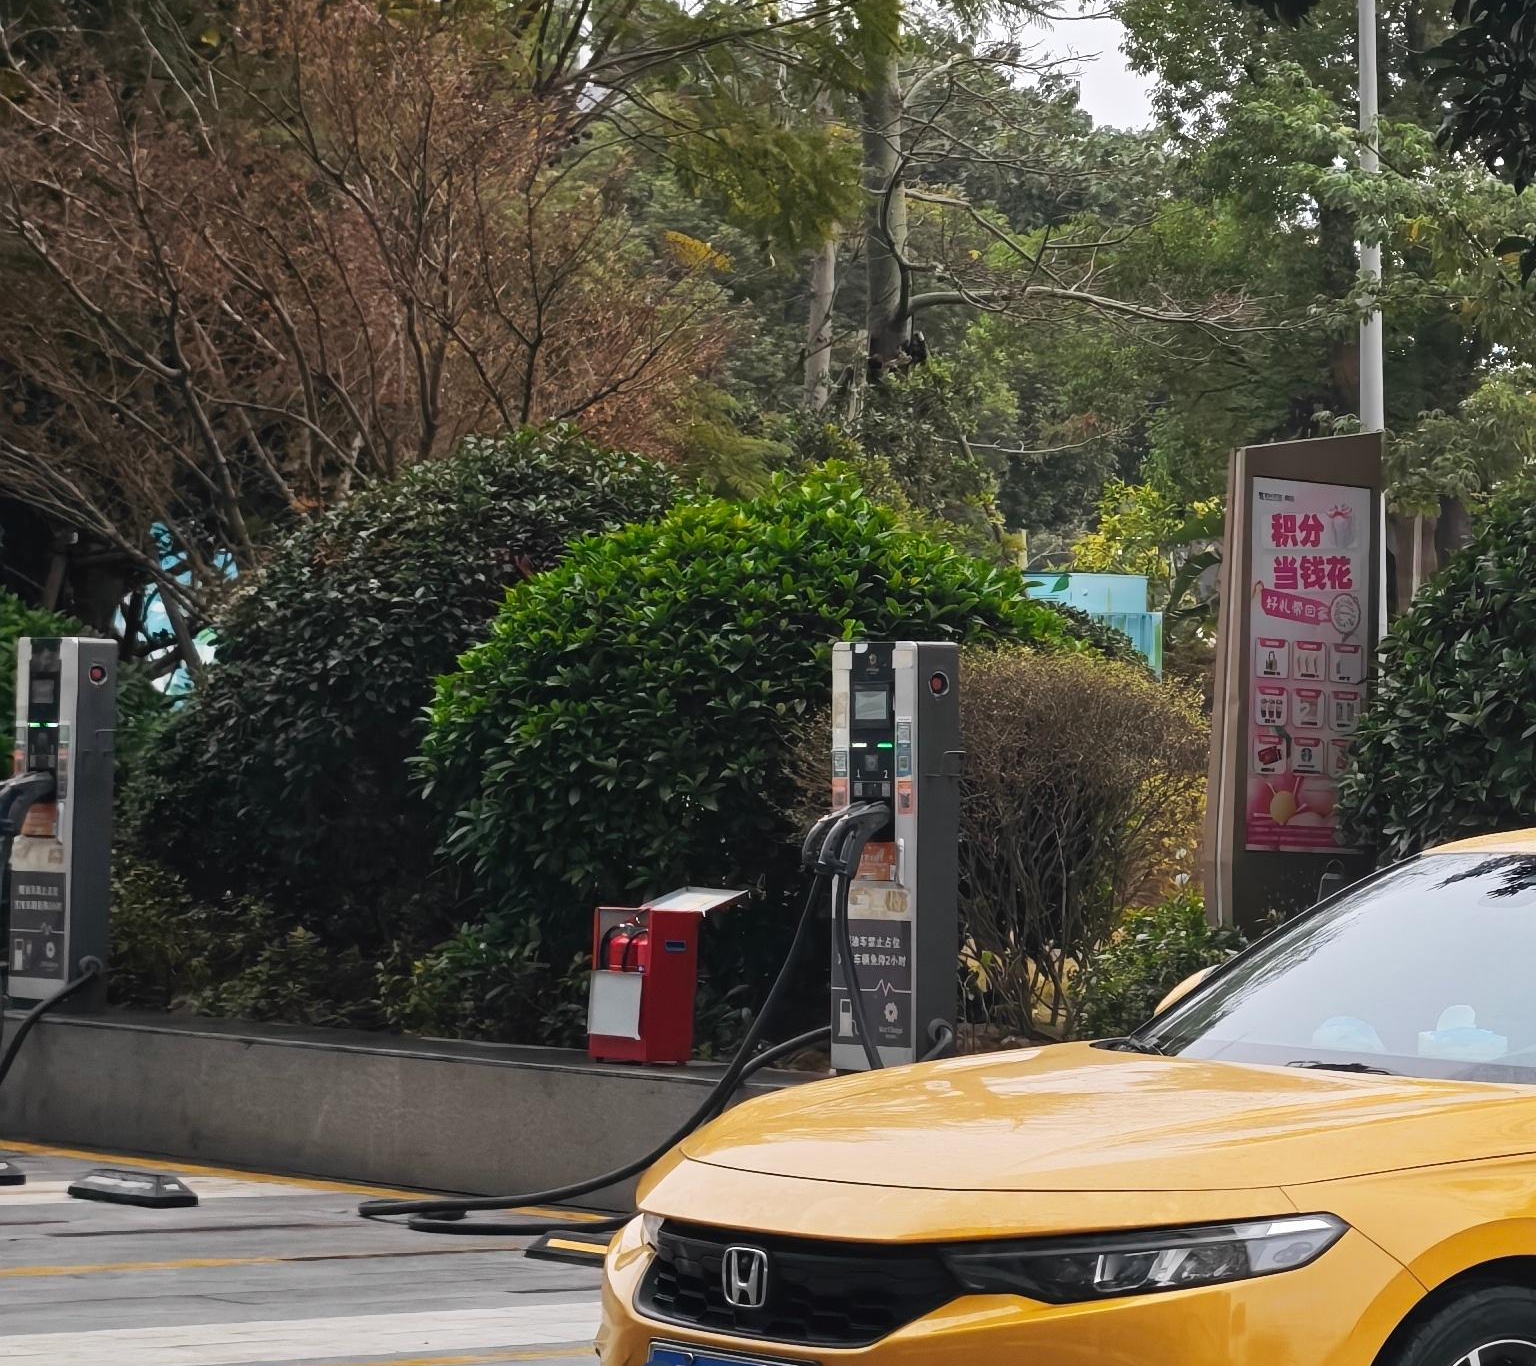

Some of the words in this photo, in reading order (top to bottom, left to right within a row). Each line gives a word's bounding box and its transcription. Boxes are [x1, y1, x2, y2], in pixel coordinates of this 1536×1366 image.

[1271, 513, 1325, 548] 积分
[1273, 555, 1353, 590] 当钱花
